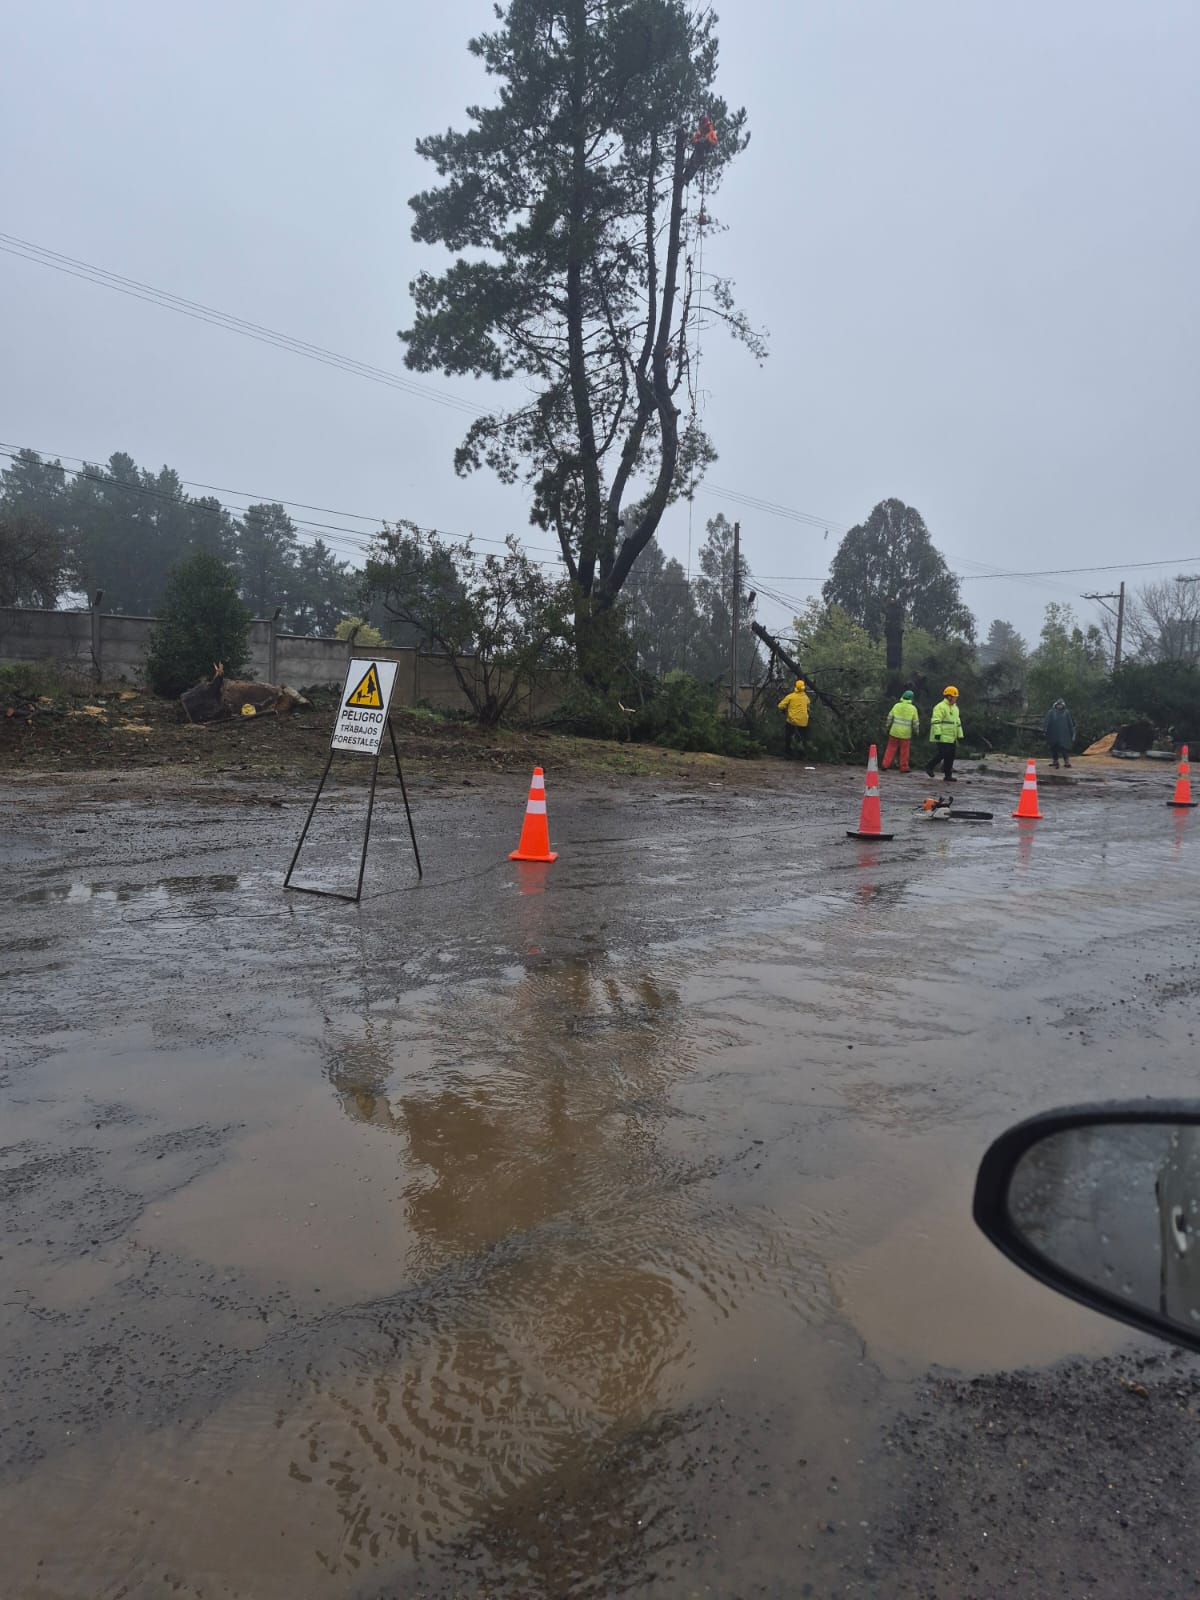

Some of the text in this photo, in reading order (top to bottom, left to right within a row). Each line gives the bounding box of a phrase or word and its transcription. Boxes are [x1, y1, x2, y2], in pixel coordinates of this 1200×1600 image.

[341, 710, 383, 723] PELIGRO
[341, 724, 377, 735] TRABAJOS
[334, 735, 379, 747] FORESTALES
